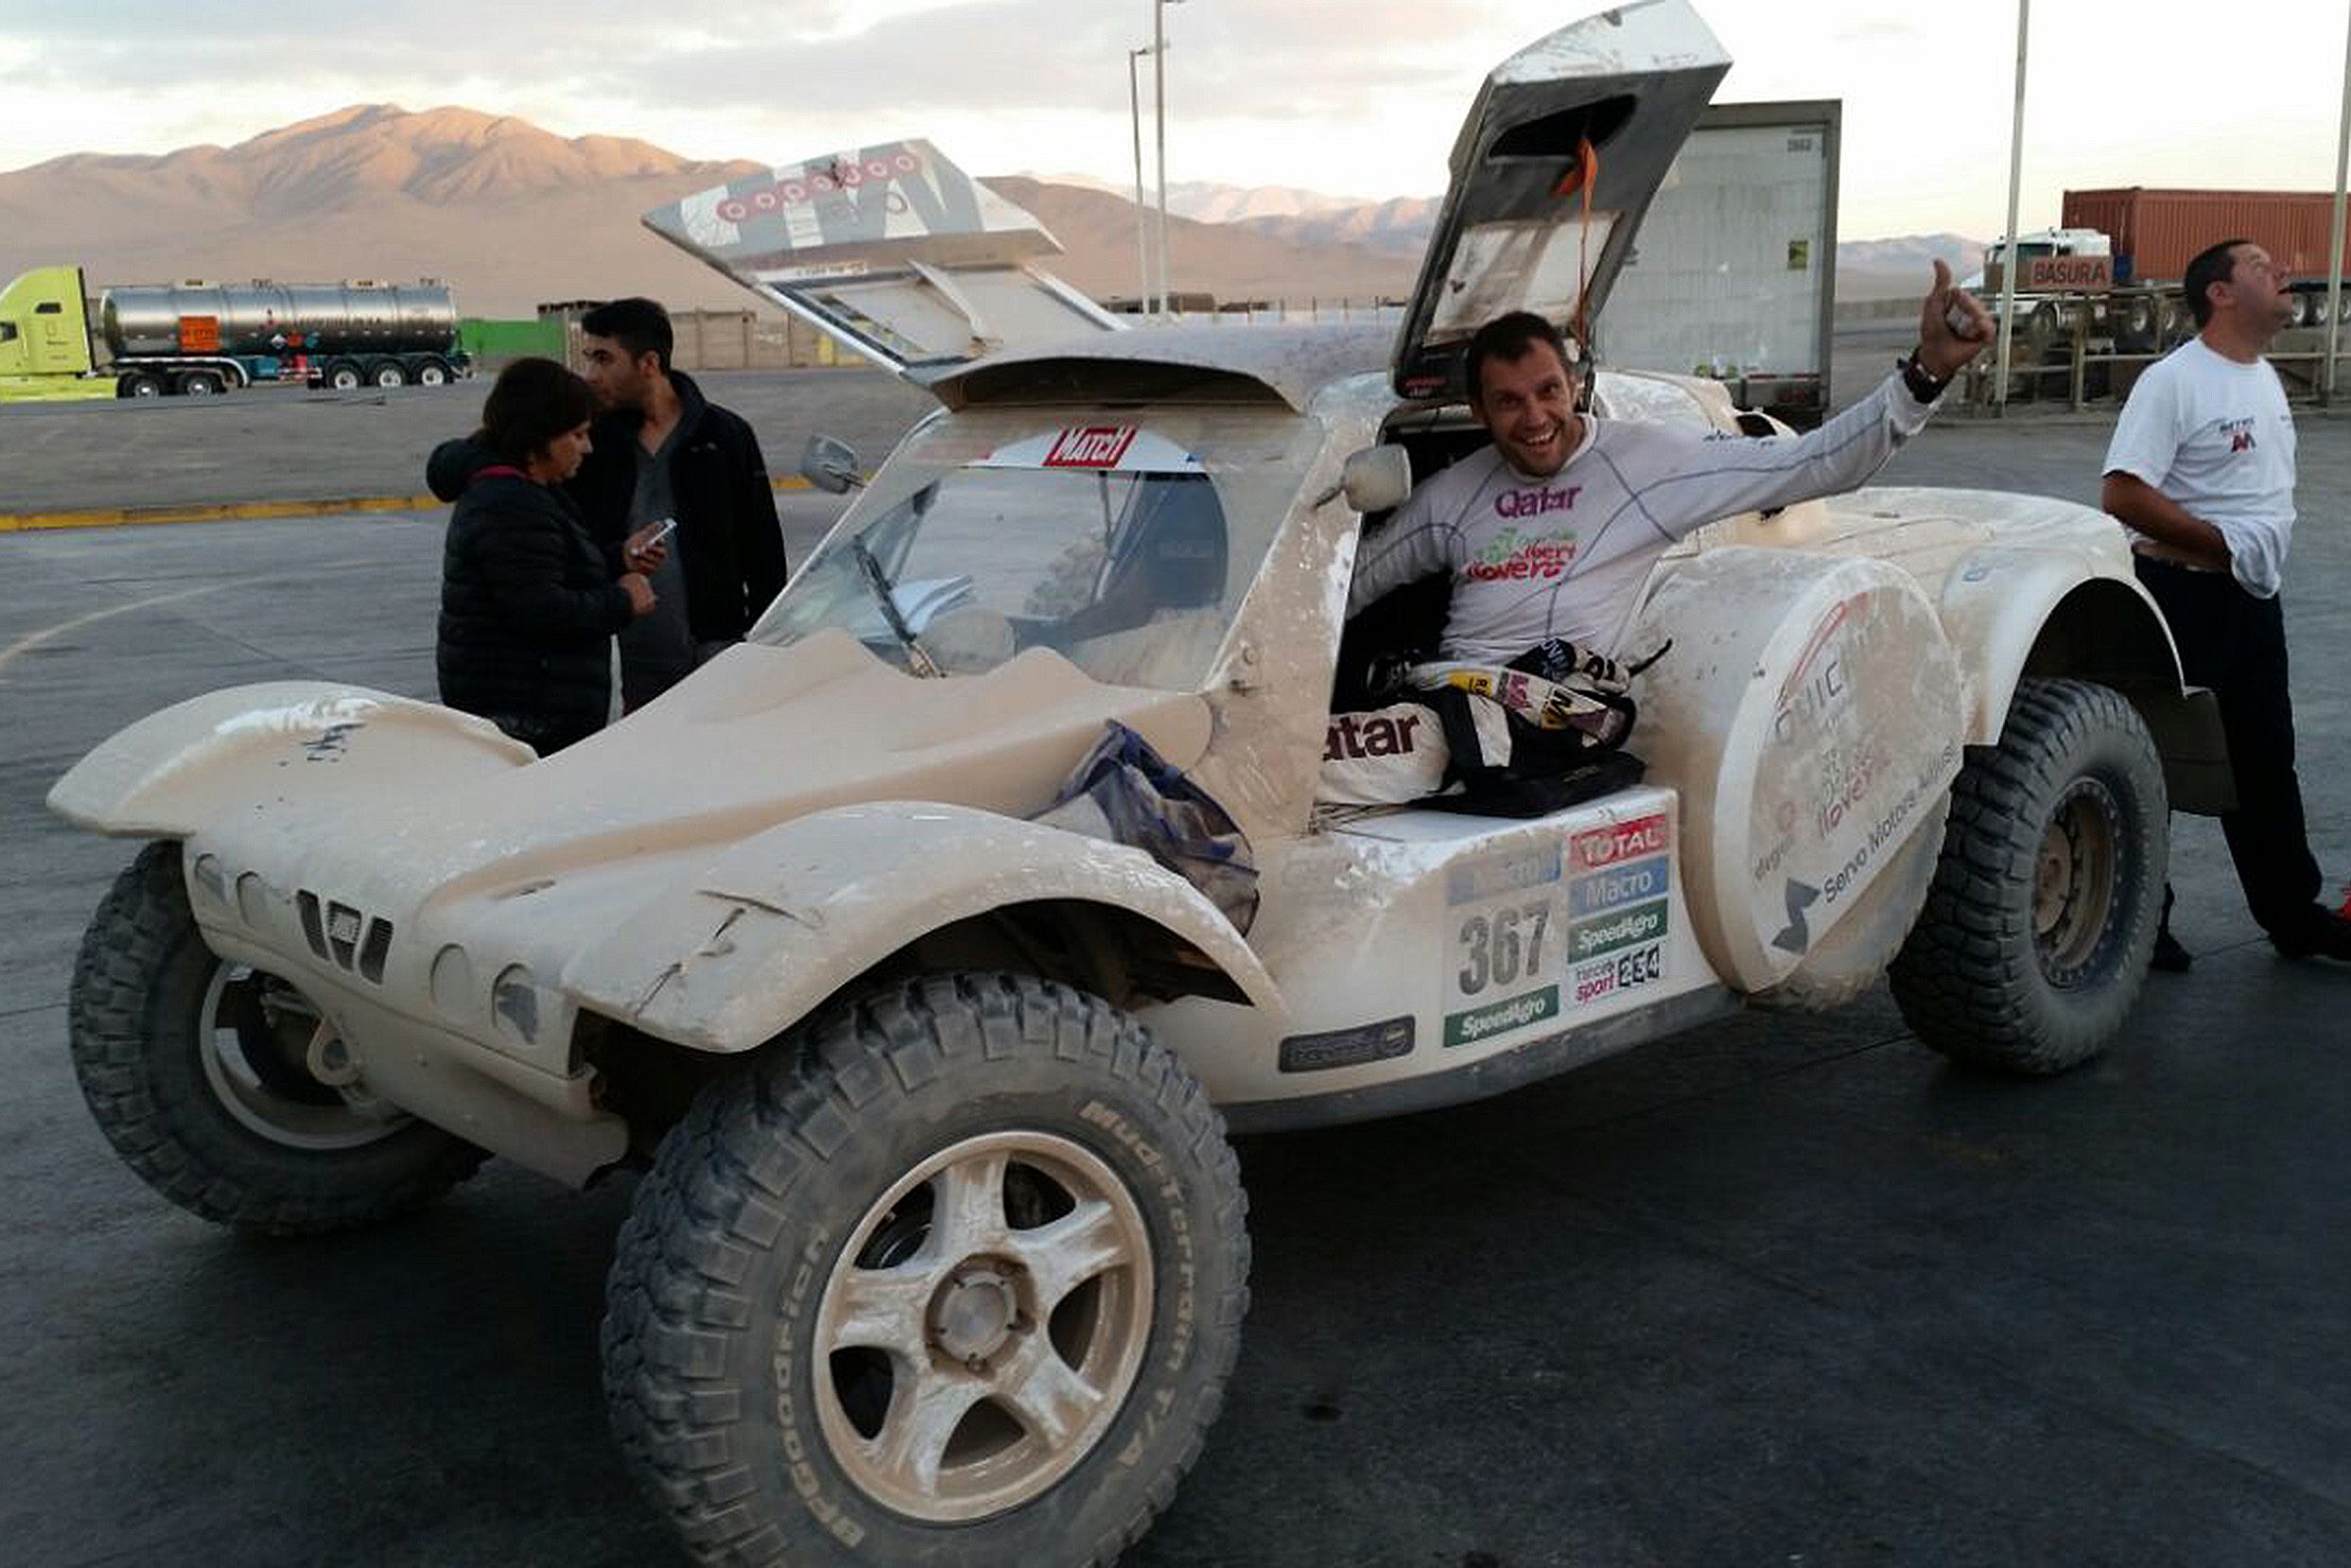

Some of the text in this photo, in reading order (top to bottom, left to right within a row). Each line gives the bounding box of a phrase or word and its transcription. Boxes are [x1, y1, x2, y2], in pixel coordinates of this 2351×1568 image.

[2034, 258, 2107, 284] BASURA
[1494, 485, 1582, 519] Qatar
[1322, 713, 1420, 761] atar
[1582, 828, 1662, 867] TOTAL
[1585, 871, 1653, 908] Macro
[1822, 848, 1868, 904] Servo
[1458, 903, 1549, 996] 367
[1577, 914, 1658, 953] SpeedAgro
